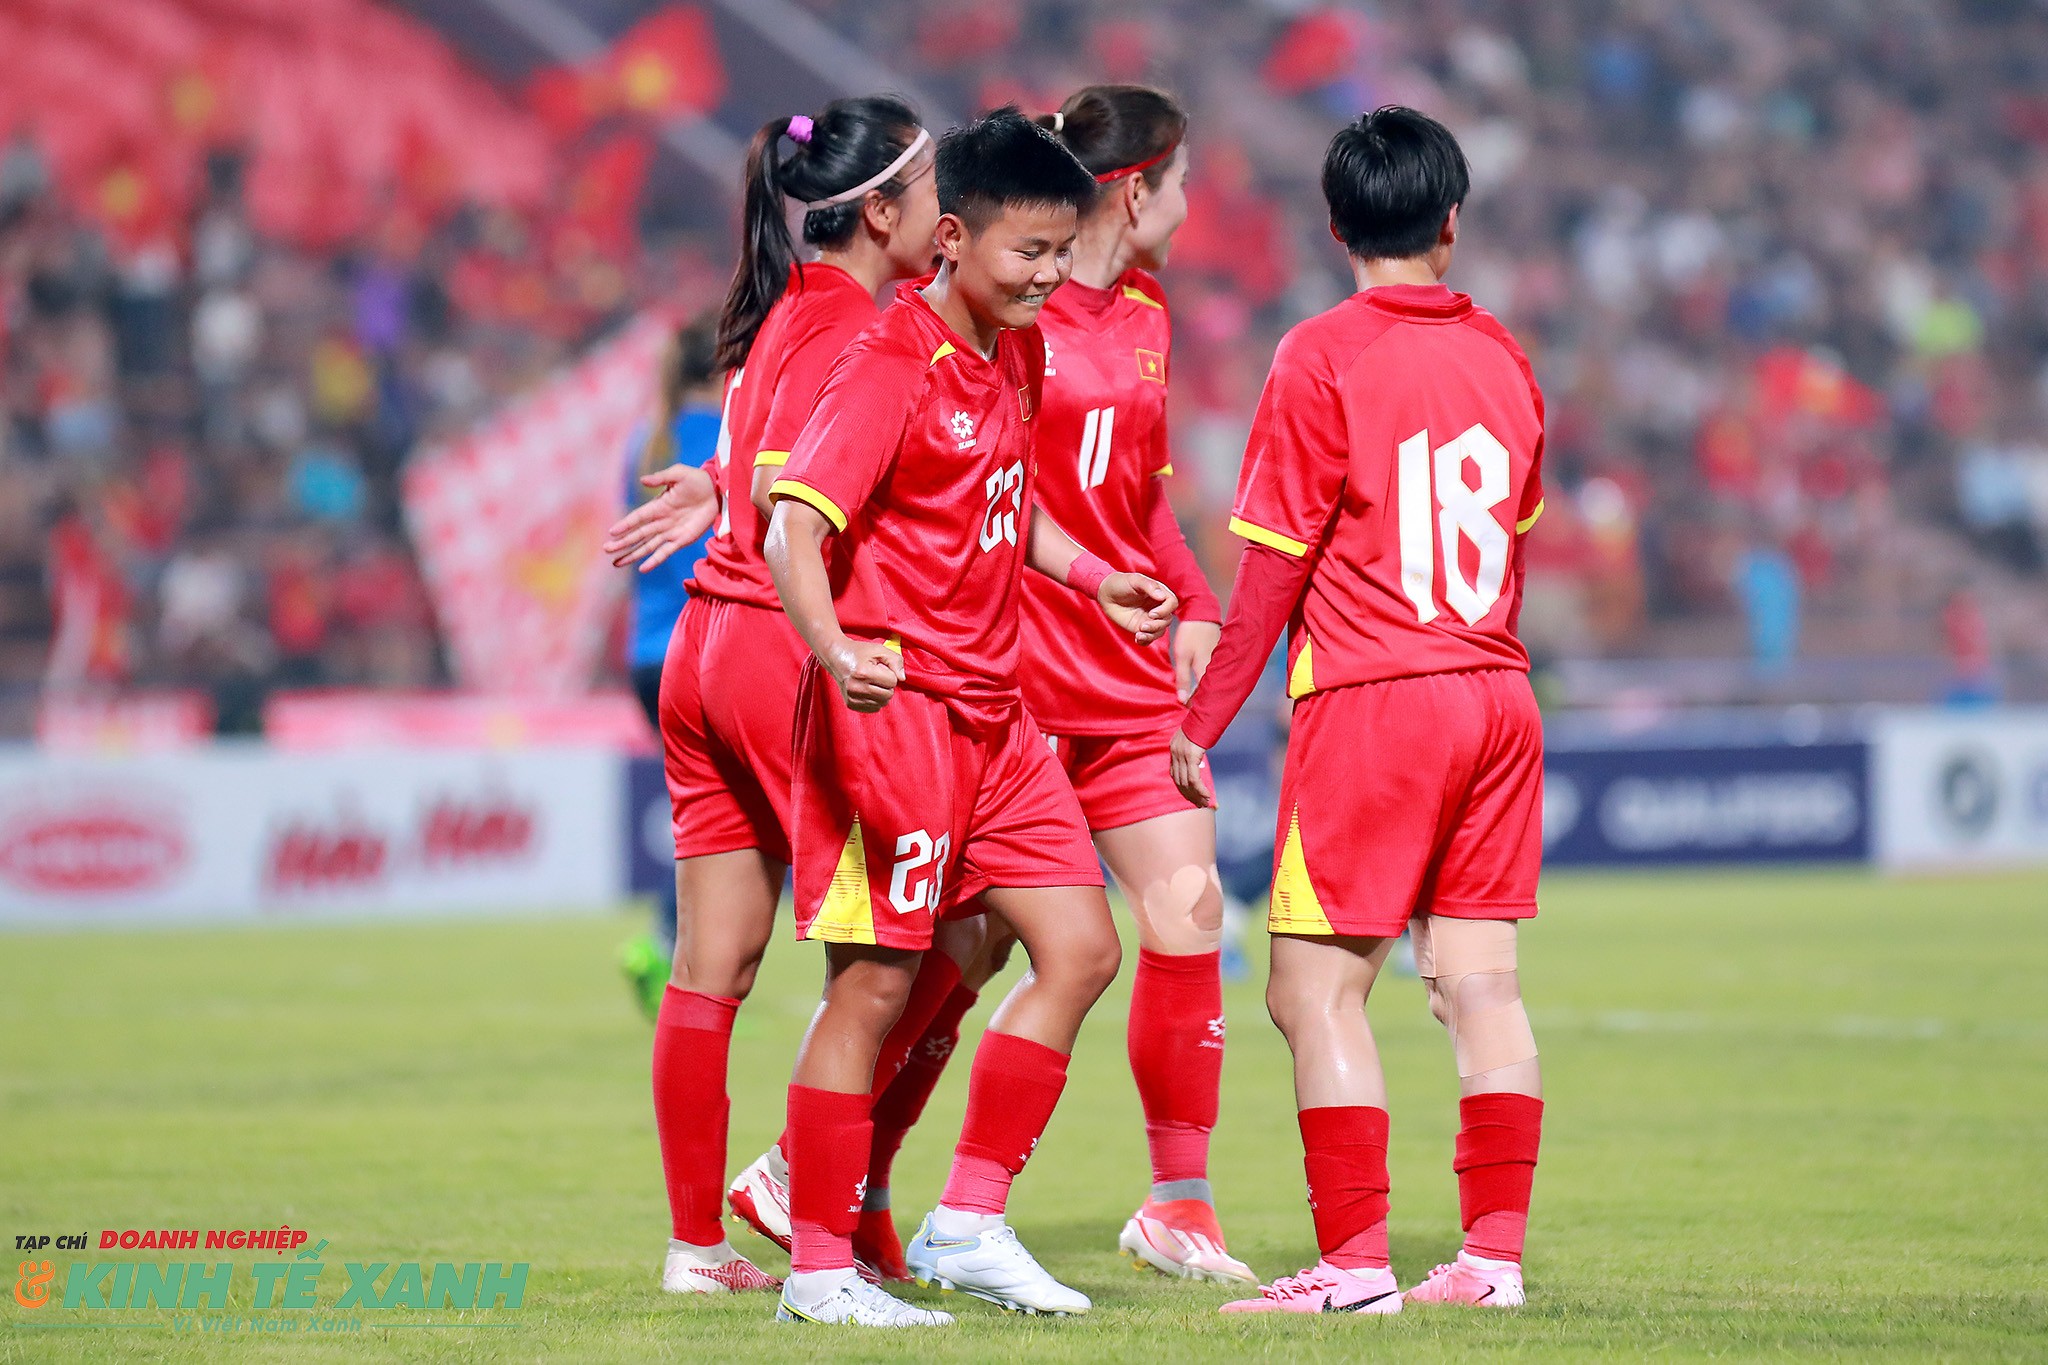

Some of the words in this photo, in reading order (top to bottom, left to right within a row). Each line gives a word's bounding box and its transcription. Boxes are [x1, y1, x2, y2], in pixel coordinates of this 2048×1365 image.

[1079, 406, 1115, 492] 11
[979, 458, 1024, 554] 23
[1398, 422, 1510, 628] 18
[888, 828, 950, 916] 23
